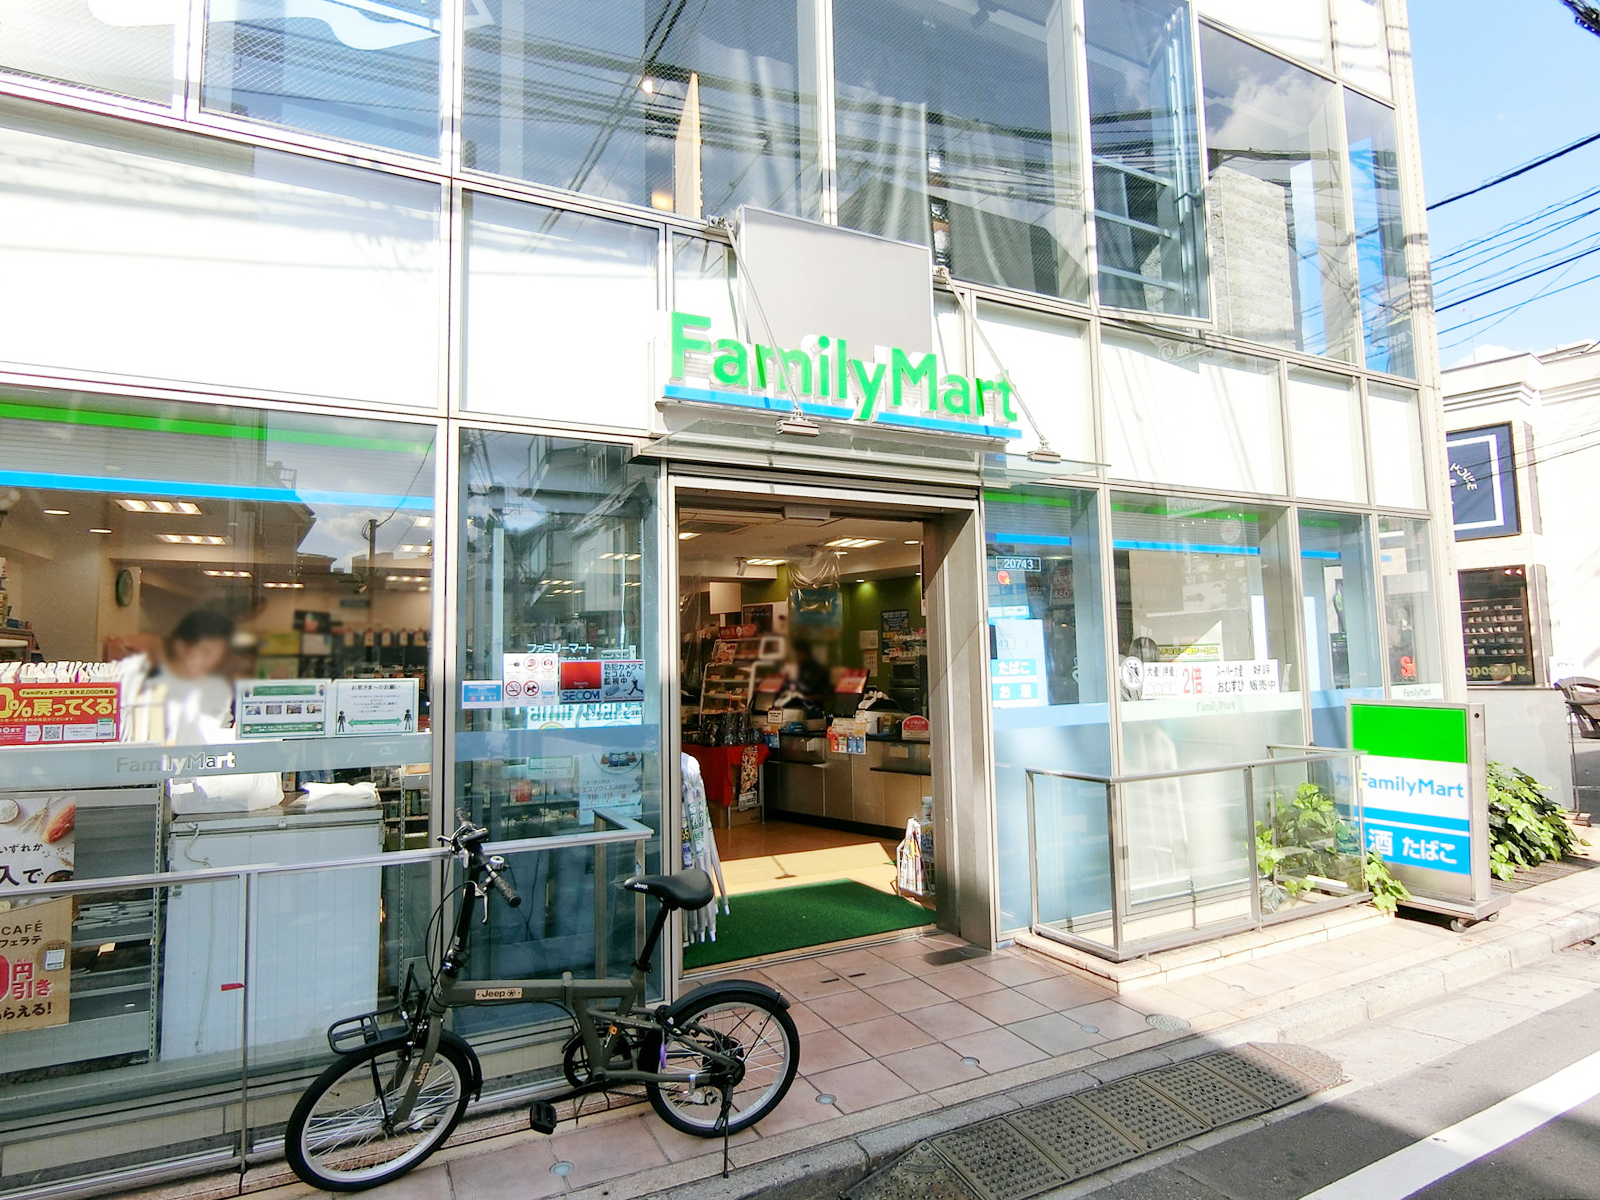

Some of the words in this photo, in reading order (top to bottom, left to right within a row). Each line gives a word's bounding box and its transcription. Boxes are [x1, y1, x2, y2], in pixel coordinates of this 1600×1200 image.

[671, 310, 1018, 422] FamilyMart
[1003, 558, 1034, 569] 20743
[527, 643, 595, 654] ファミリーマート
[604, 663, 643, 671] 防犯カメラで
[998, 660, 1030, 674] たばこ
[604, 677, 628, 685] 監視中
[1183, 667, 1203, 694] 2倍
[1217, 680, 1245, 693] おむすび
[1249, 680, 1276, 691] 販売中
[562, 690, 601, 701] SECOM
[999, 685, 1032, 699] お酒
[1403, 688, 1431, 699] FamilyMart
[1196, 701, 1236, 713] FamilyMart
[116, 751, 236, 774] FamilyMart
[1368, 828, 1393, 857] 酒
[1402, 836, 1457, 865] たばこ
[1, 920, 43, 936] CAFÉ
[12, 979, 52, 1000] 引き
[481, 989, 506, 998] Jeep
[414, 1062, 431, 1087] Jeep
